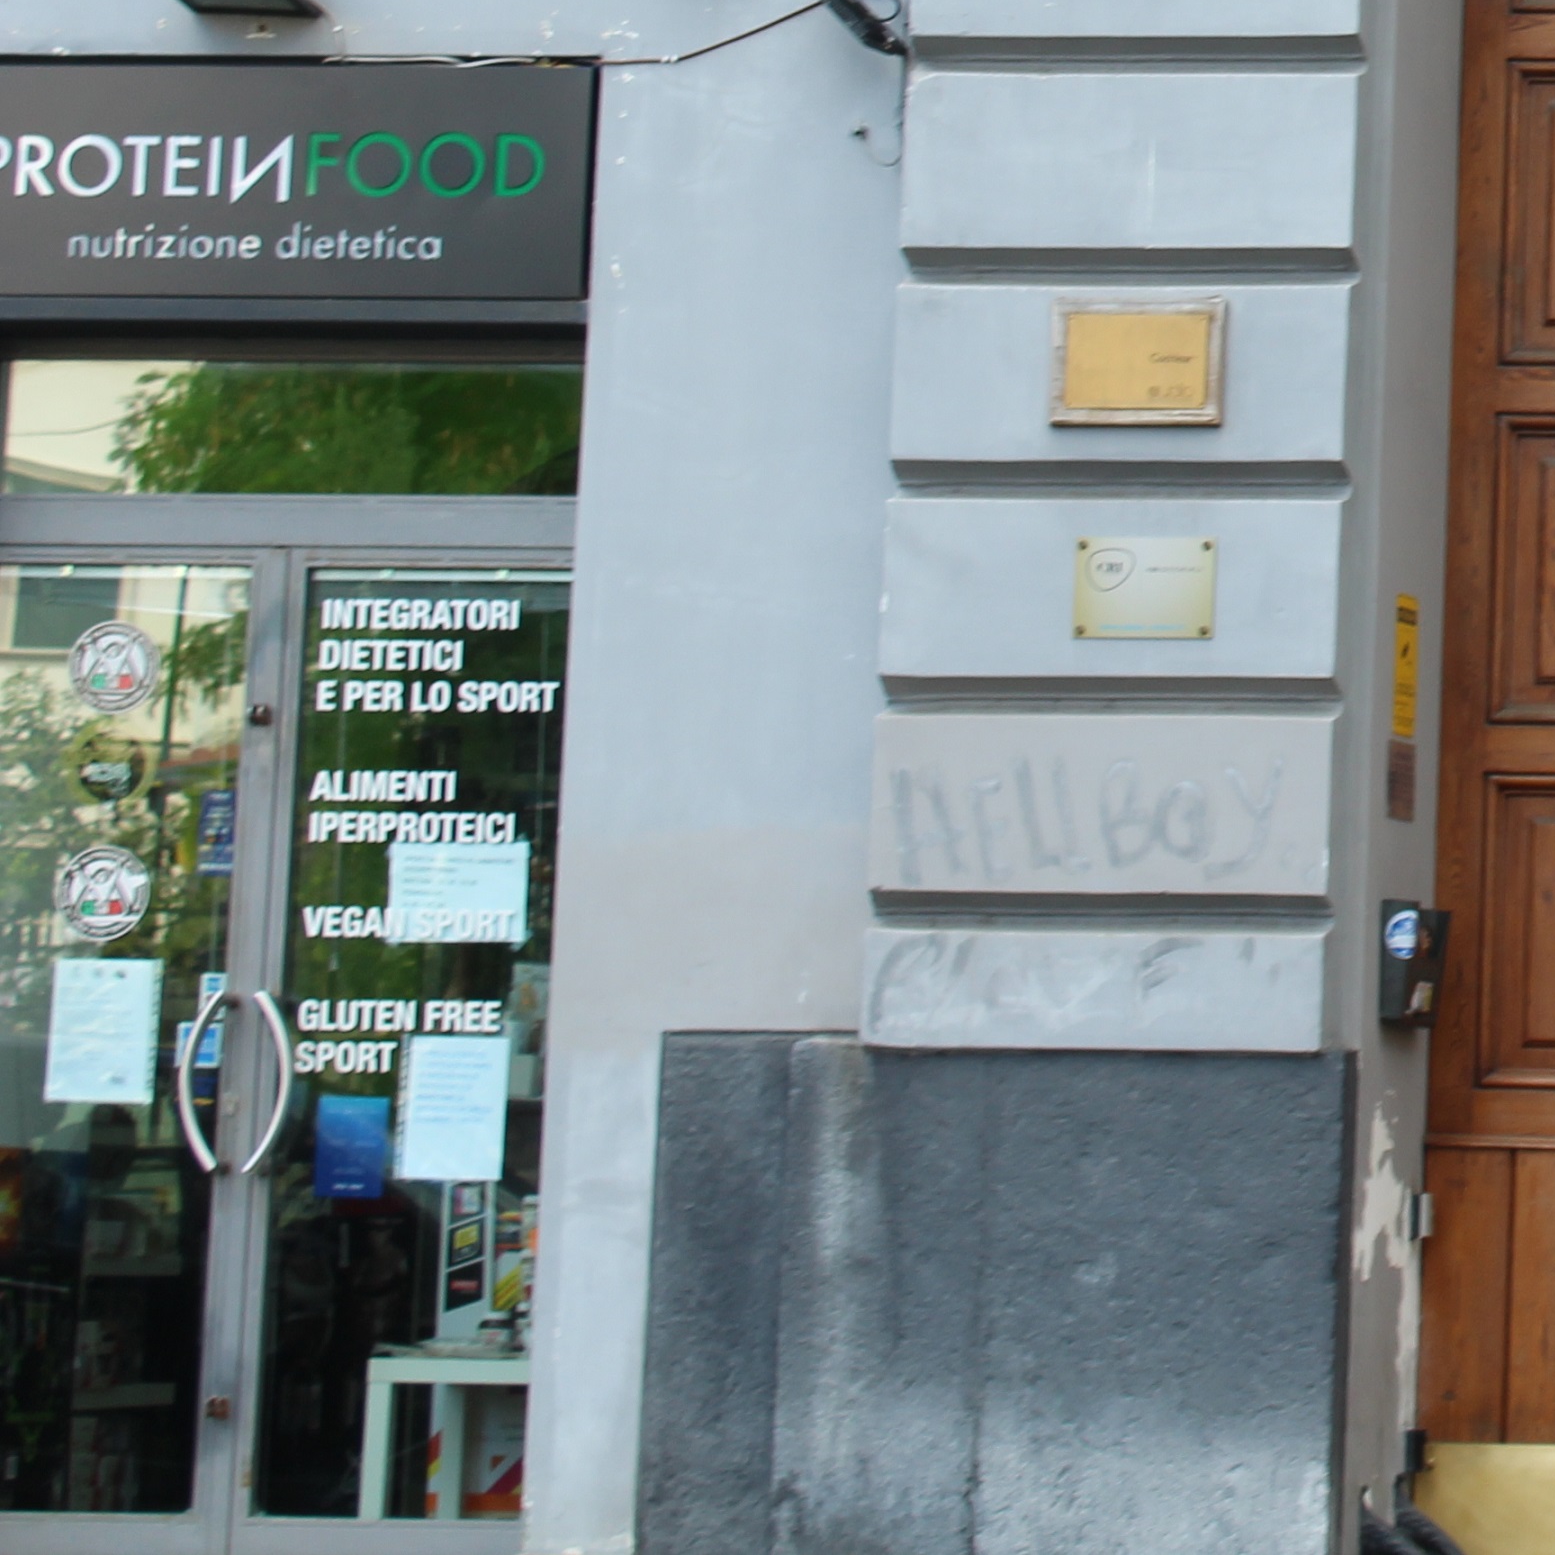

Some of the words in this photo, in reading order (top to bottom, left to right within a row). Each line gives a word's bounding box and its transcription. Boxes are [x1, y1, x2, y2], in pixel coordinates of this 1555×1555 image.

[66, 223, 262, 261] nutrizione
[274, 221, 444, 261] dietetica
[320, 598, 522, 631] INTEGRATORI
[317, 638, 465, 672] DIETETICI
[315, 679, 338, 712] E
[342, 679, 405, 712] PER
[410, 679, 452, 712] LO
[456, 679, 560, 713] SPORT
[308, 769, 458, 803] ALIMENTI
[308, 810, 517, 844] IPERPROTEICI
[302, 905, 405, 938] VEGAN
[417, 908, 515, 939] SPORT
[297, 998, 418, 1032] GLUTEN
[423, 999, 503, 1033] FREE
[293, 1040, 398, 1074] SPORT
